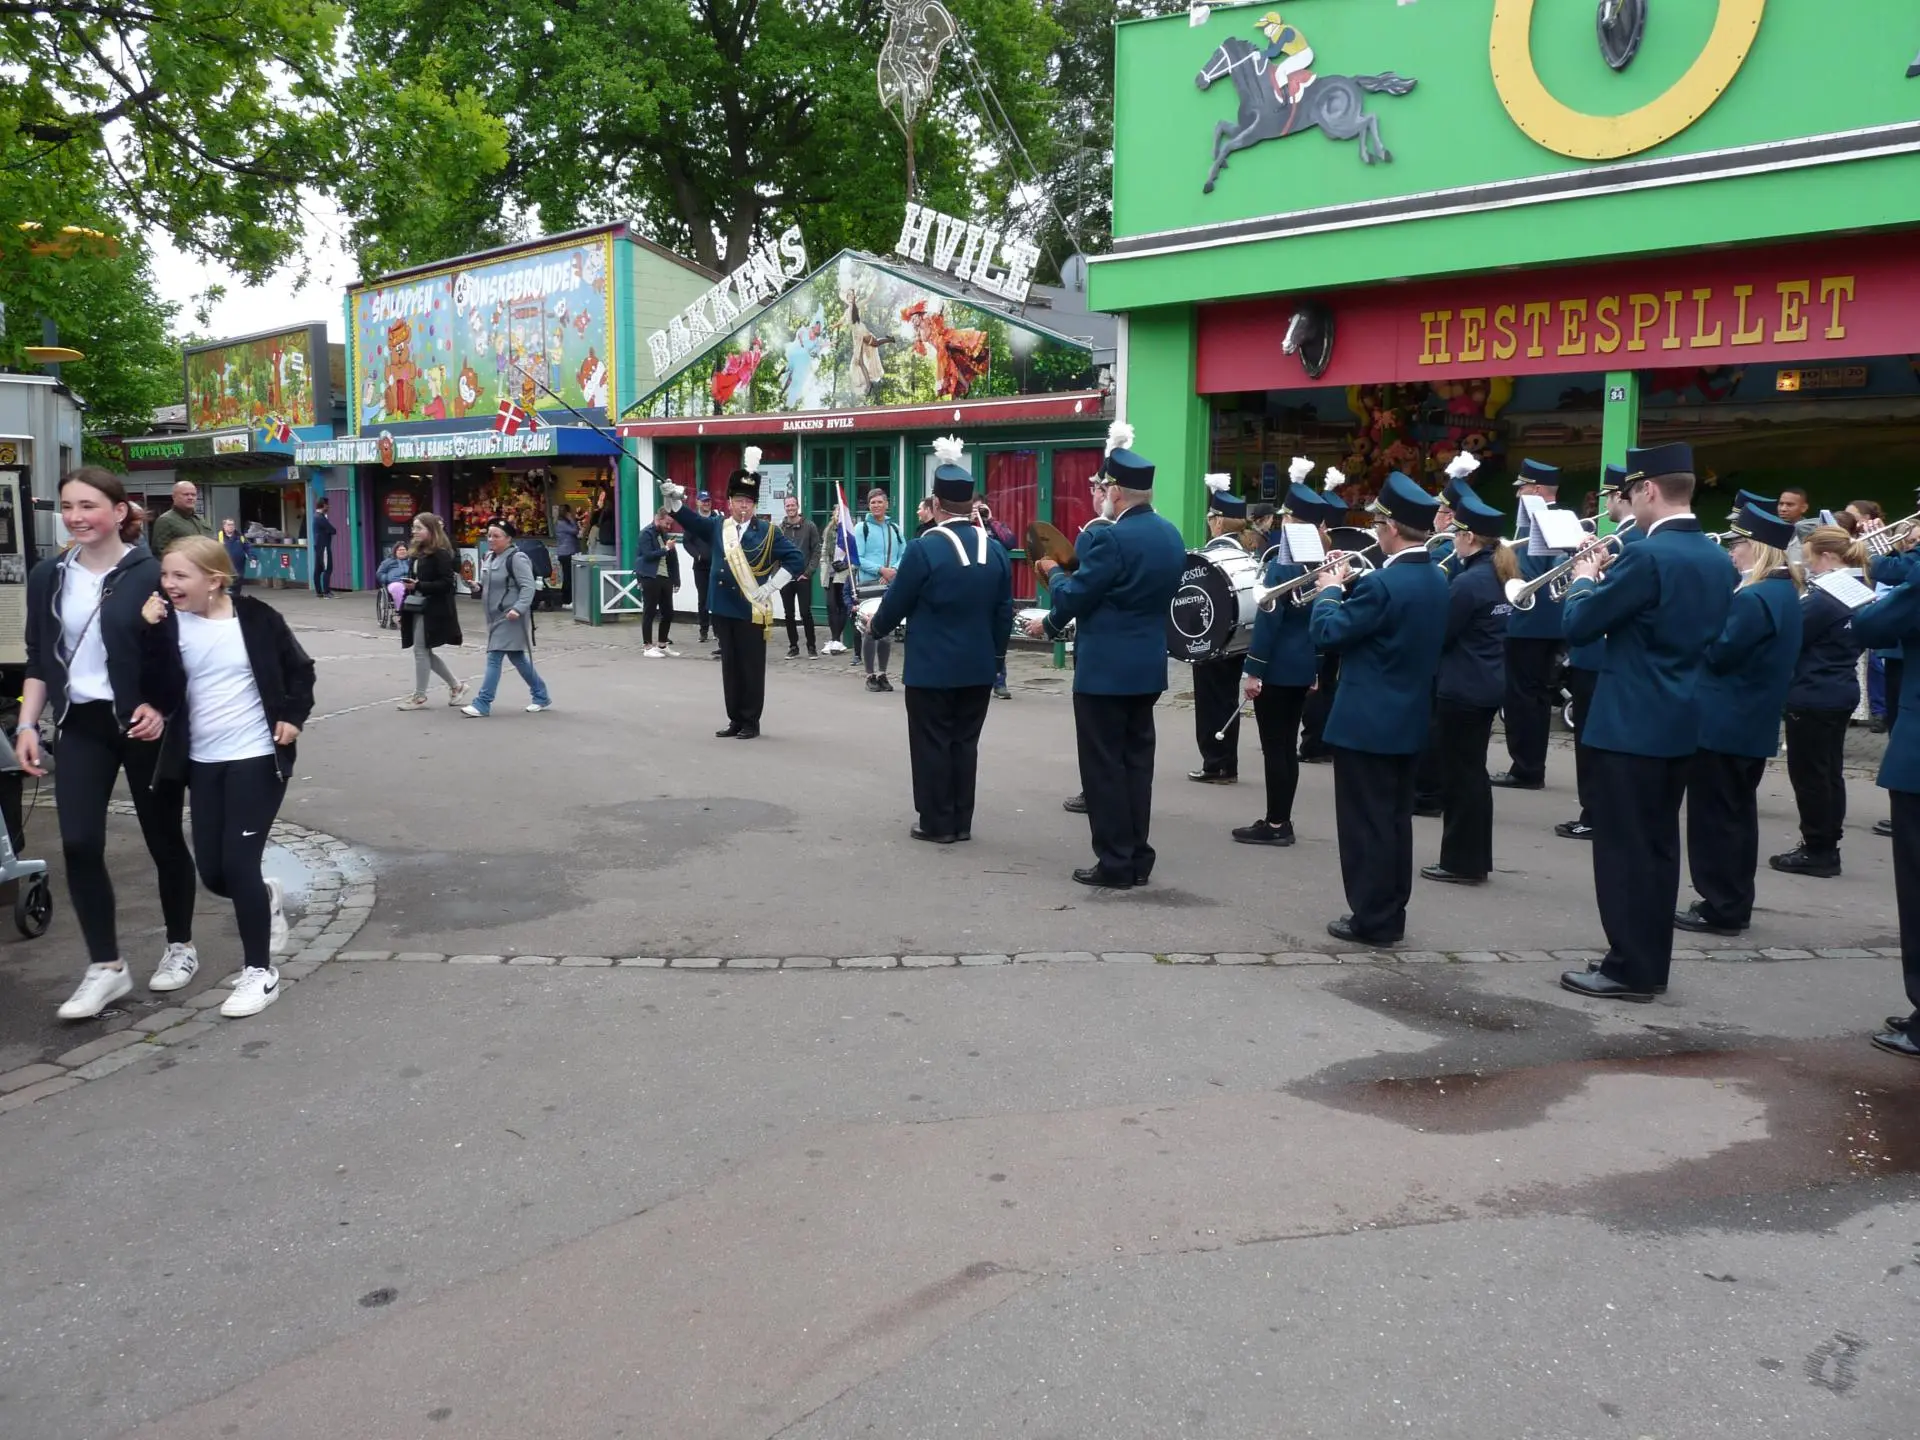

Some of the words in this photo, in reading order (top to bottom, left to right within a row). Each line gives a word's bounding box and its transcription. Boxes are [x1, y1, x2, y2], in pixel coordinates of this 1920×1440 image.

[646, 224, 806, 377] BAKKENS
[895, 202, 1041, 302] HVILE
[1419, 276, 1855, 364] HESTESPILLET
[783, 420, 823, 431] BAKKENS
[827, 418, 854, 428] HVILE
[526, 433, 551, 452] GANG
[1174, 595, 1206, 607] AMICITIA
